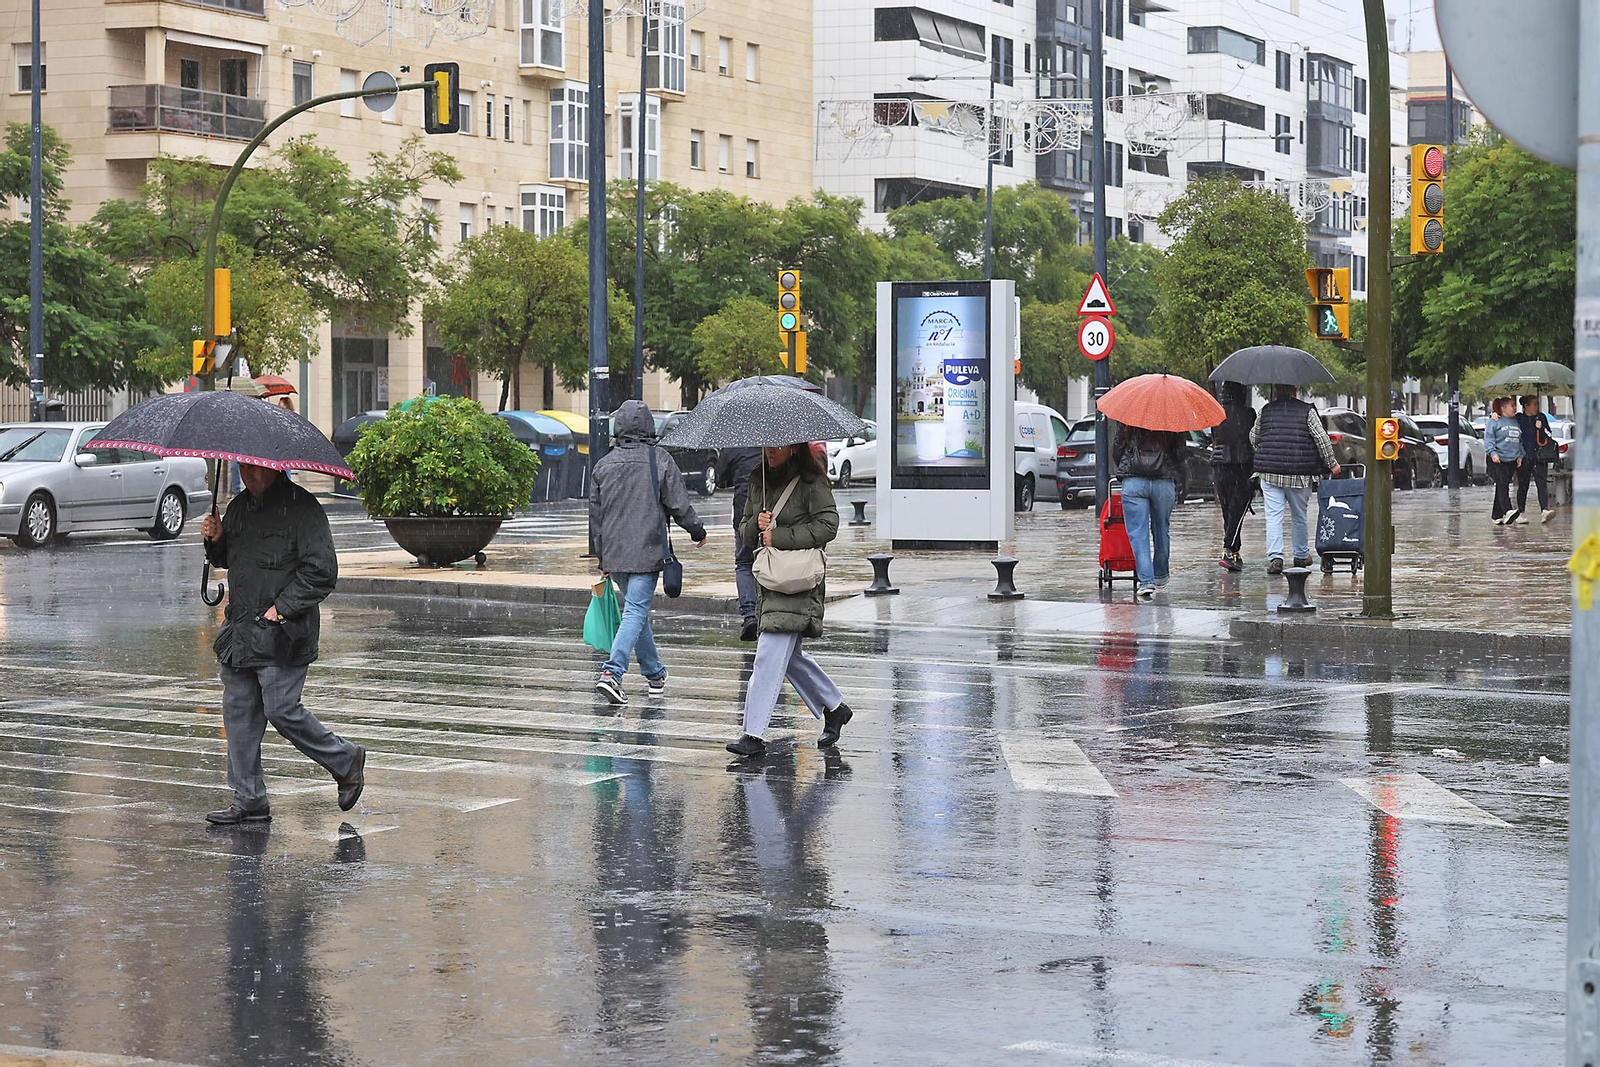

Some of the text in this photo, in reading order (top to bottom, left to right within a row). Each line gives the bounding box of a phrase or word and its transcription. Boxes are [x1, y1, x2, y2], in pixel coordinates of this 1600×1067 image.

[1087, 331, 1104, 347] 30
[945, 364, 980, 375] PULEVA
[962, 409, 981, 420] A+D
